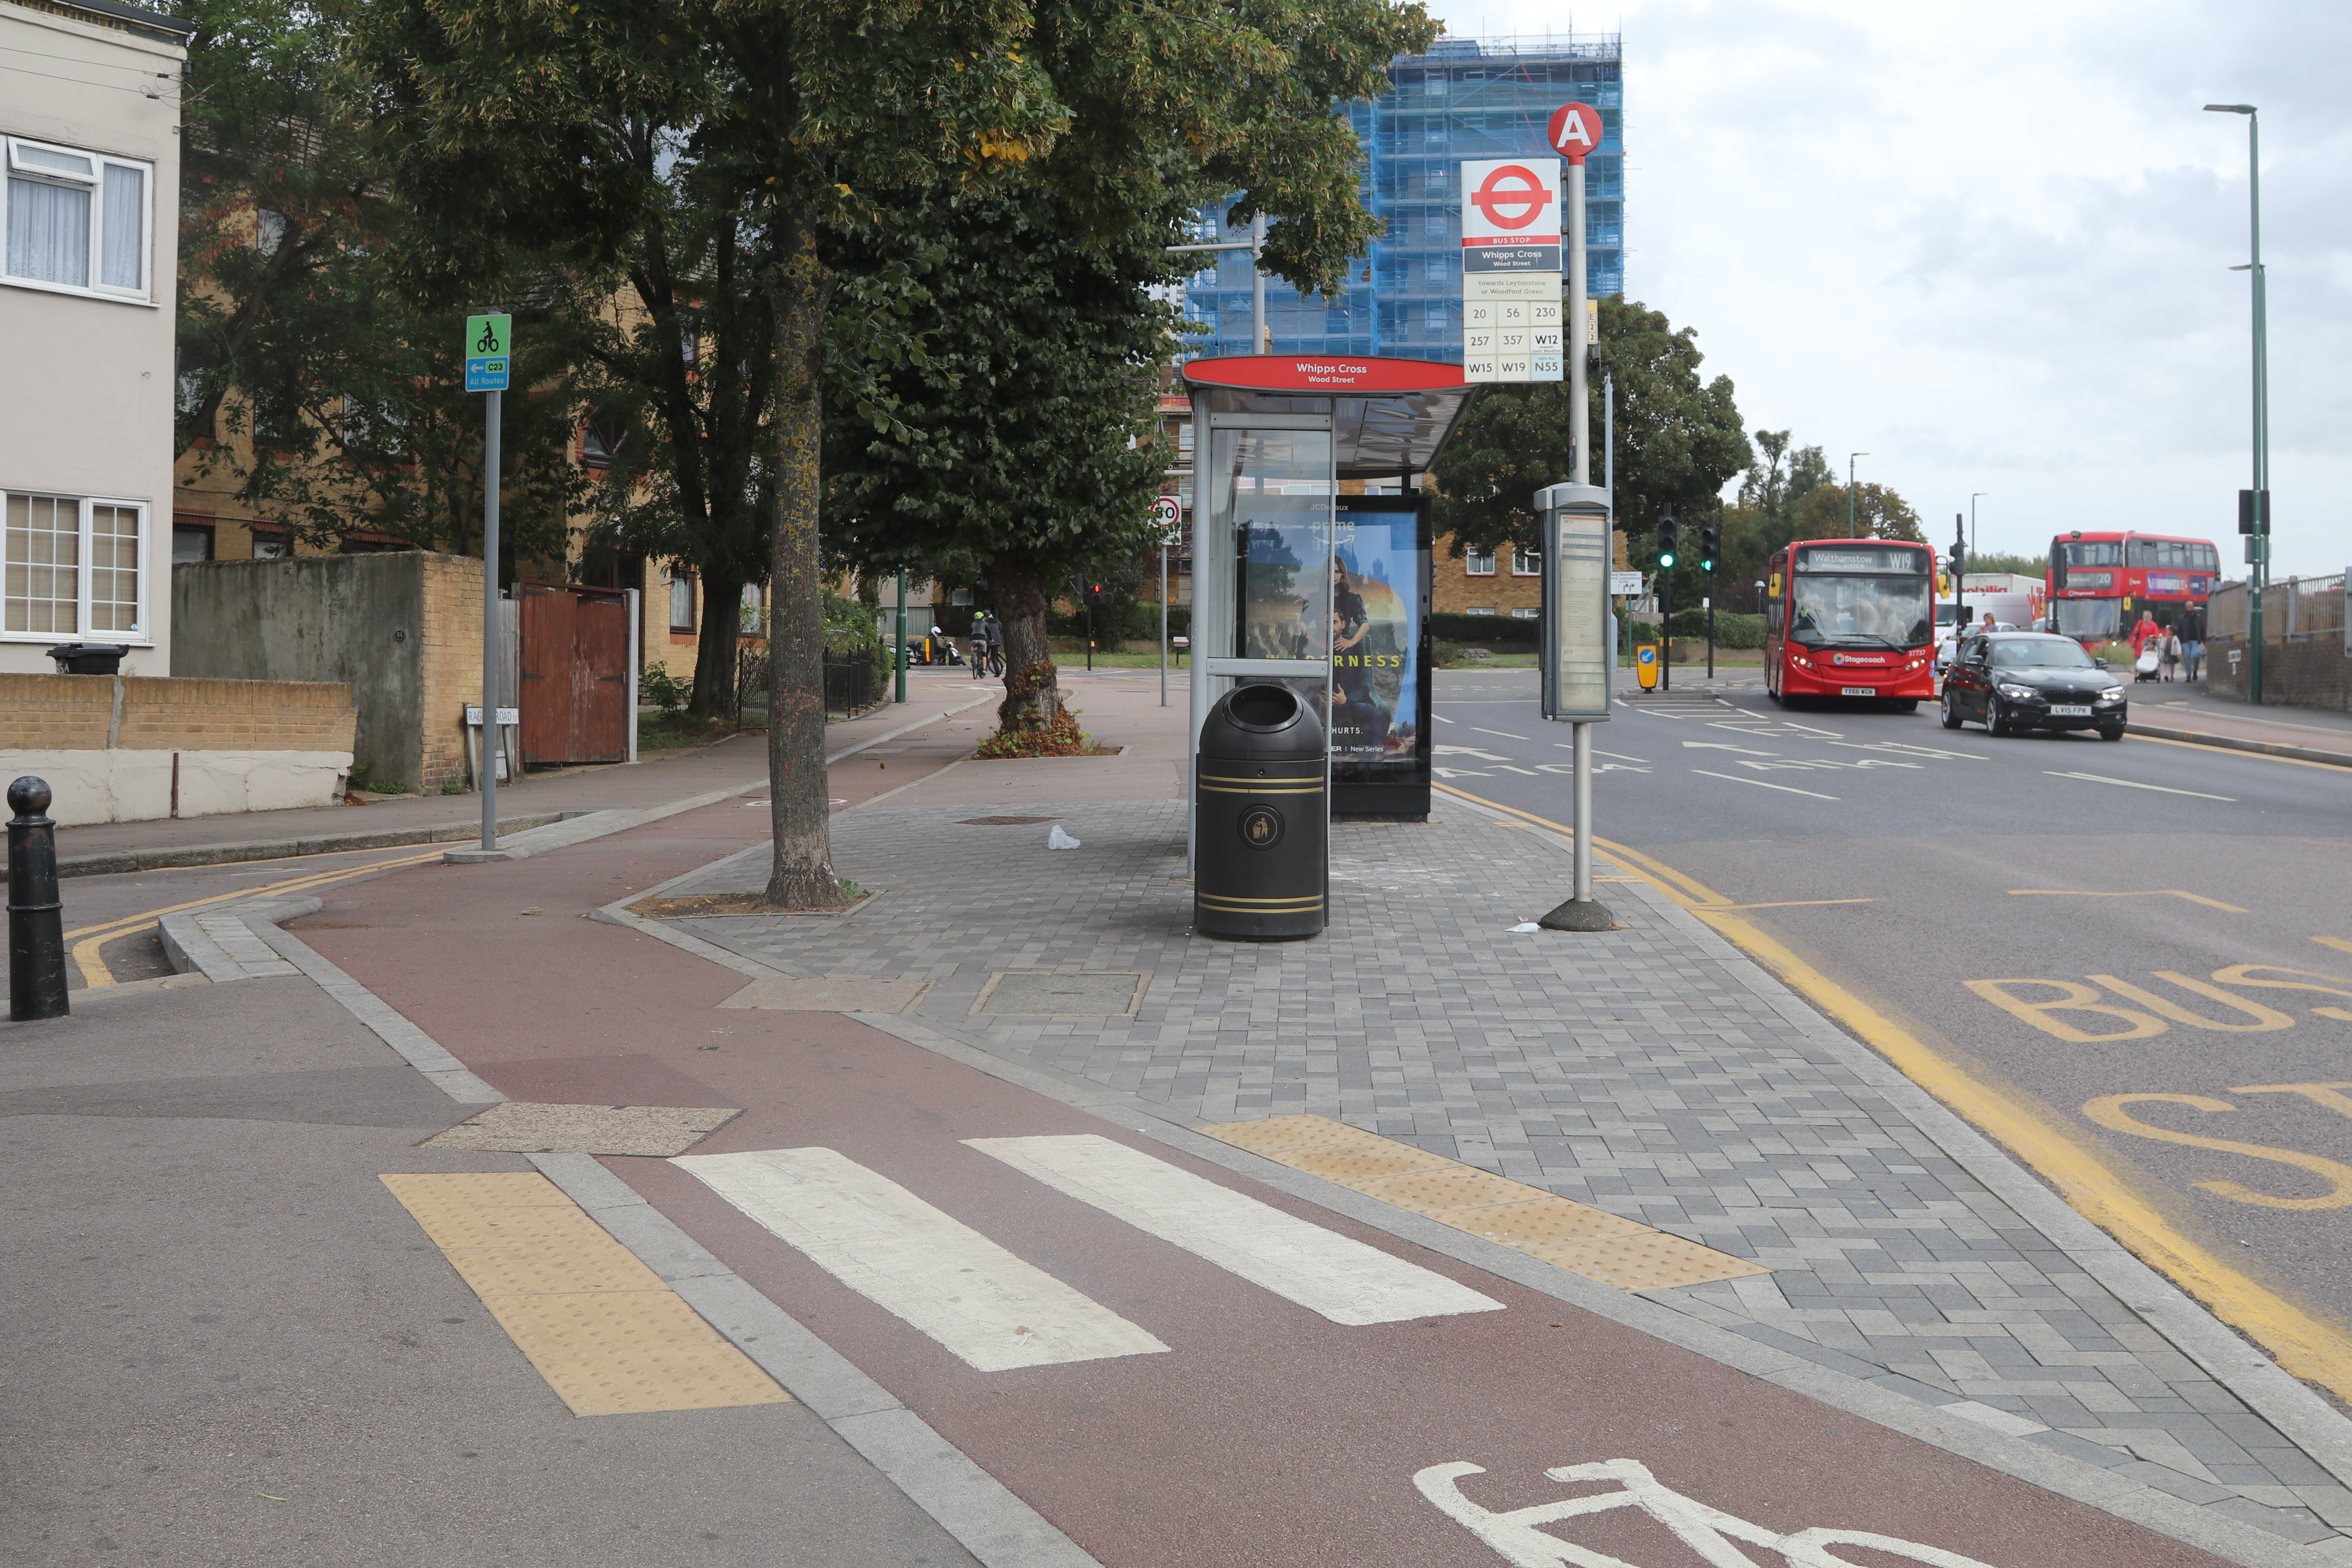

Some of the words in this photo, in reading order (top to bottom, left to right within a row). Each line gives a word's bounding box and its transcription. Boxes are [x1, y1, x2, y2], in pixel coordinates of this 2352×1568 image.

[1557, 110, 1592, 148] A
[1481, 251, 1515, 260] Whipps
[1473, 309, 1486, 319] 20
[1506, 308, 1520, 318] 56
[1535, 307, 1555, 317] 230
[1470, 336, 1490, 346] 257
[1503, 335, 1523, 345] 357
[1535, 335, 1558, 344] W12
[1296, 363, 1336, 375] Whipps
[1338, 364, 1367, 373] Cross
[1468, 363, 1492, 372] W15
[1501, 362, 1525, 372] W19
[1535, 362, 1558, 372] N55
[1312, 521, 1355, 534] prme
[1815, 553, 1872, 563] Walthamstow
[1889, 553, 1911, 569] W19
[2099, 574, 2111, 584] 20
[1845, 655, 1885, 664] Stagecoach
[468, 711, 483, 721] RAG
[496, 711, 512, 721] ROAD
